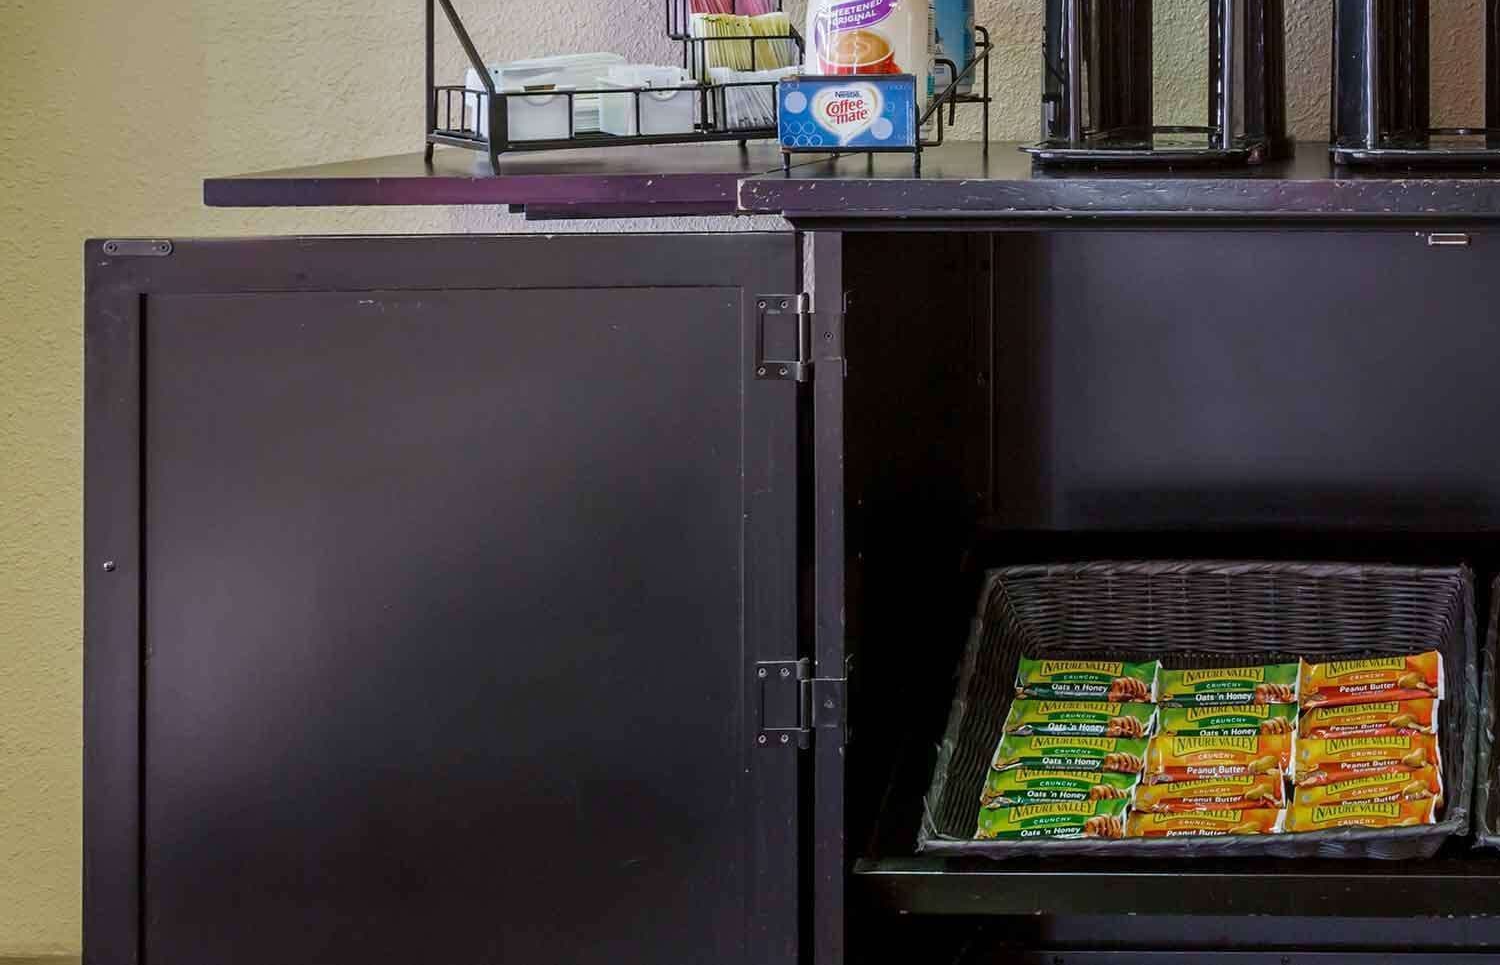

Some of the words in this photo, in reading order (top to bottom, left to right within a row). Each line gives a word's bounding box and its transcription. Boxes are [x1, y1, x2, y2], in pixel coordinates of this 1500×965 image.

[826, 99, 864, 117] Coffee
[836, 109, 868, 125] mate
[1044, 661, 1082, 672] NATURE
[1083, 661, 1121, 672] VALLEY
[1329, 660, 1367, 674] NATURE
[1369, 658, 1402, 670] VALLEY
[1186, 669, 1224, 682] NATURE
[1226, 668, 1263, 681] VALLEY
[1082, 683, 1109, 693] Honey
[1340, 684, 1367, 692] Peanut
[1226, 693, 1253, 701] Honey
[1079, 723, 1105, 733] Honey
[1034, 737, 1073, 749] NATURE
[1074, 737, 1113, 750] VALLEY
[1177, 737, 1218, 752] NATURE
[1219, 737, 1255, 750] VALLEY
[1042, 757, 1062, 765] Oats
[1074, 758, 1101, 767] Honey
[1060, 792, 1087, 800] Honey
[1014, 804, 1054, 818] NATURE
[1055, 802, 1095, 813] VALLEY
[1316, 805, 1357, 819] NATURE
[1359, 803, 1395, 815] VALLEY
[1053, 827, 1080, 835] Honey
